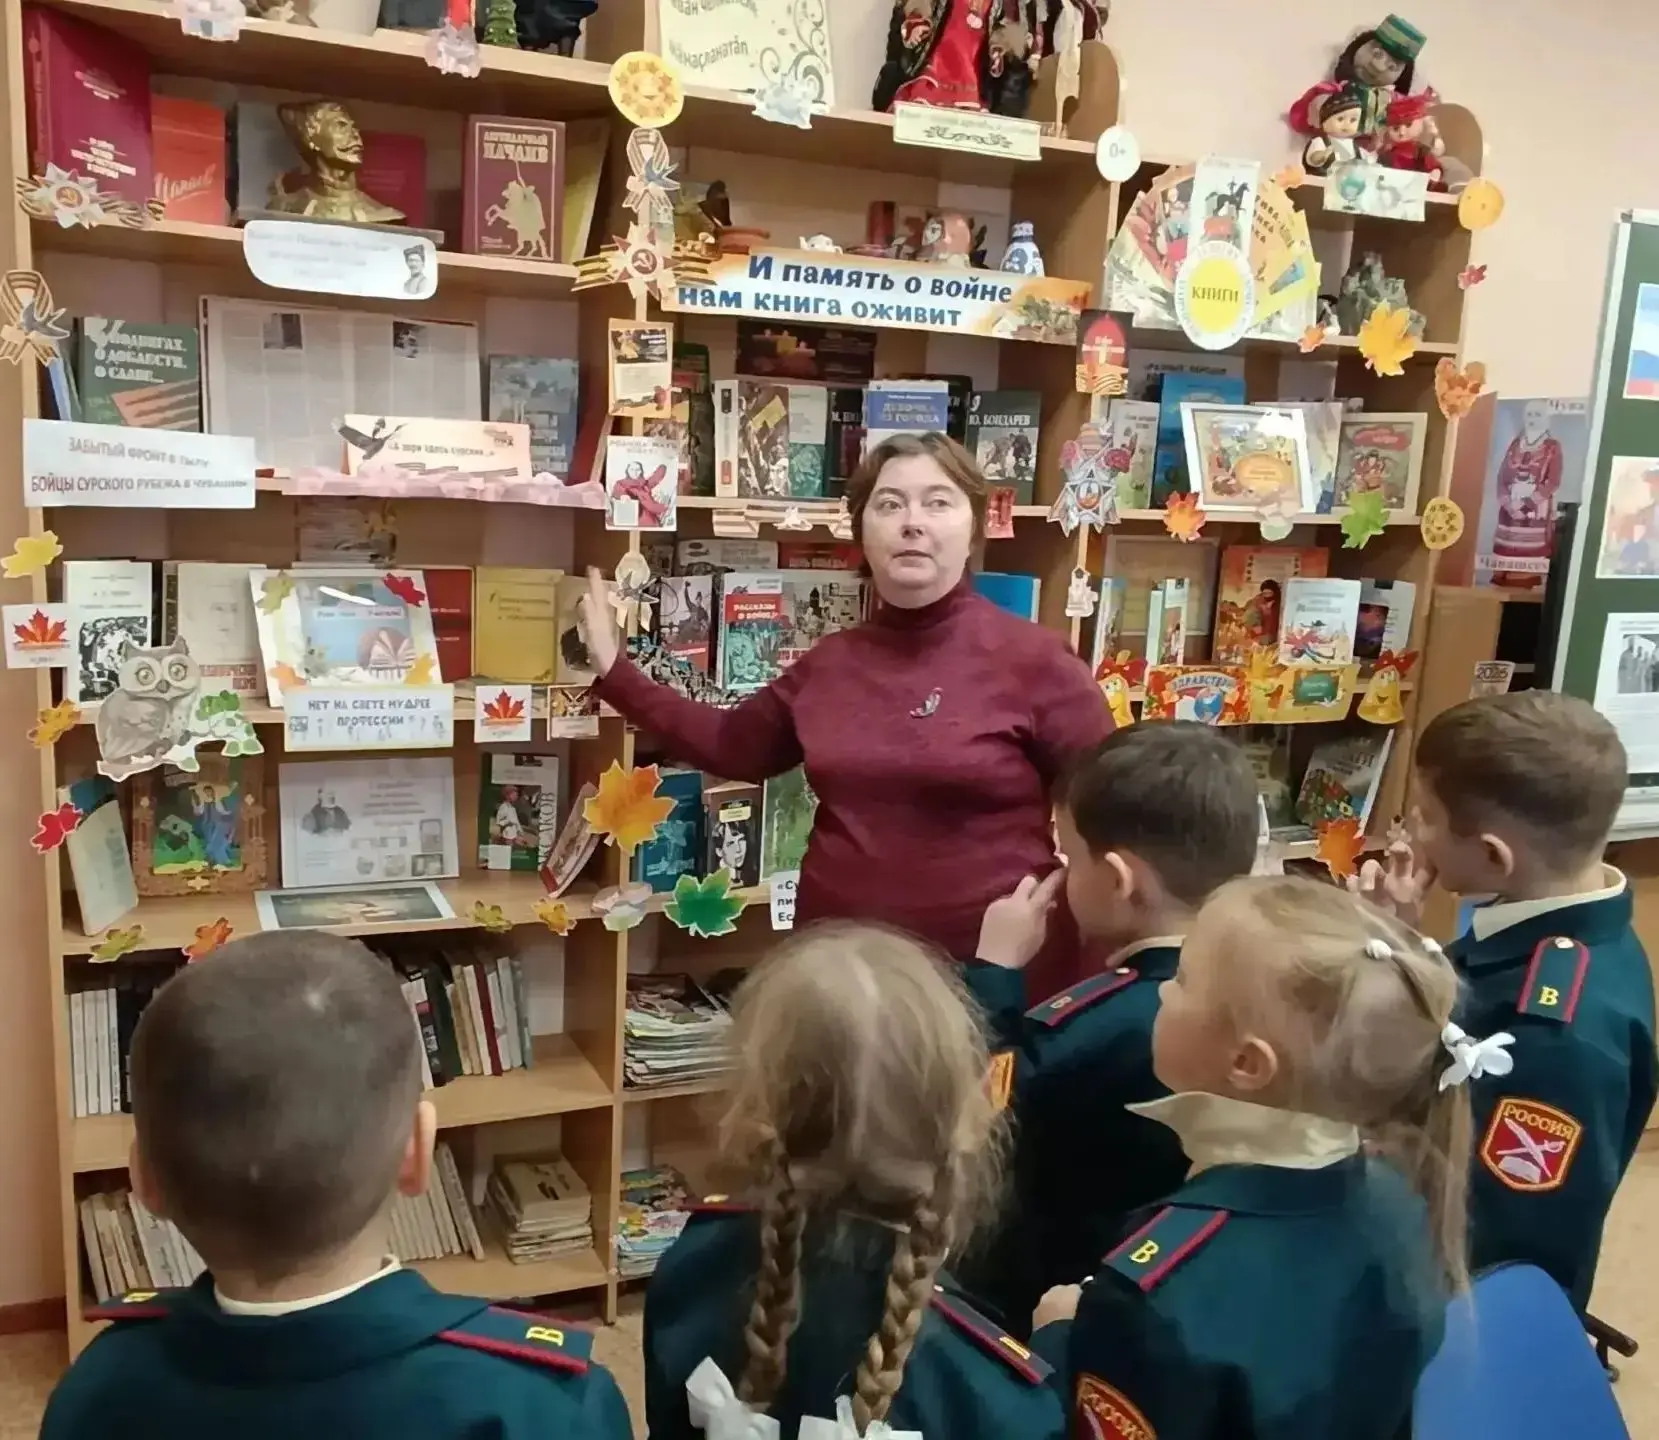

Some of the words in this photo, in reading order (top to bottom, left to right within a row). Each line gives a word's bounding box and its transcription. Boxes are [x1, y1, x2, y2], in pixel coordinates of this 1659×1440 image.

[748, 255, 773, 280] И
[782, 265, 896, 291] память
[904, 276, 922, 294] о
[929, 278, 1013, 303] войне
[1191, 286, 1239, 304] КНИГИ
[678, 286, 743, 309] нам
[753, 294, 842, 316] книга
[851, 300, 962, 327] оживит
[94, 365, 106, 378] О
[983, 413, 1031, 426] БОНДАРЕВ
[69, 436, 125, 457] ЗАБЫТЫЙ
[128, 447, 167, 464] ФРОНТ
[31, 472, 75, 495] БОЙЦЫ
[77, 477, 135, 491] СУРСКОГО
[137, 478, 181, 491] РУБЕЖА
[308, 700, 330, 711] НЕТ
[334, 700, 348, 710] НА
[352, 700, 385, 710] СВЕТЕ
[388, 698, 431, 710] МУДРЕЕ
[337, 715, 404, 727] ПРОФЕССИИ
[1537, 986, 1560, 1006] В
[1503, 1103, 1575, 1139] РОССИЯ
[1128, 1239, 1160, 1264] В
[525, 1325, 565, 1347] В
